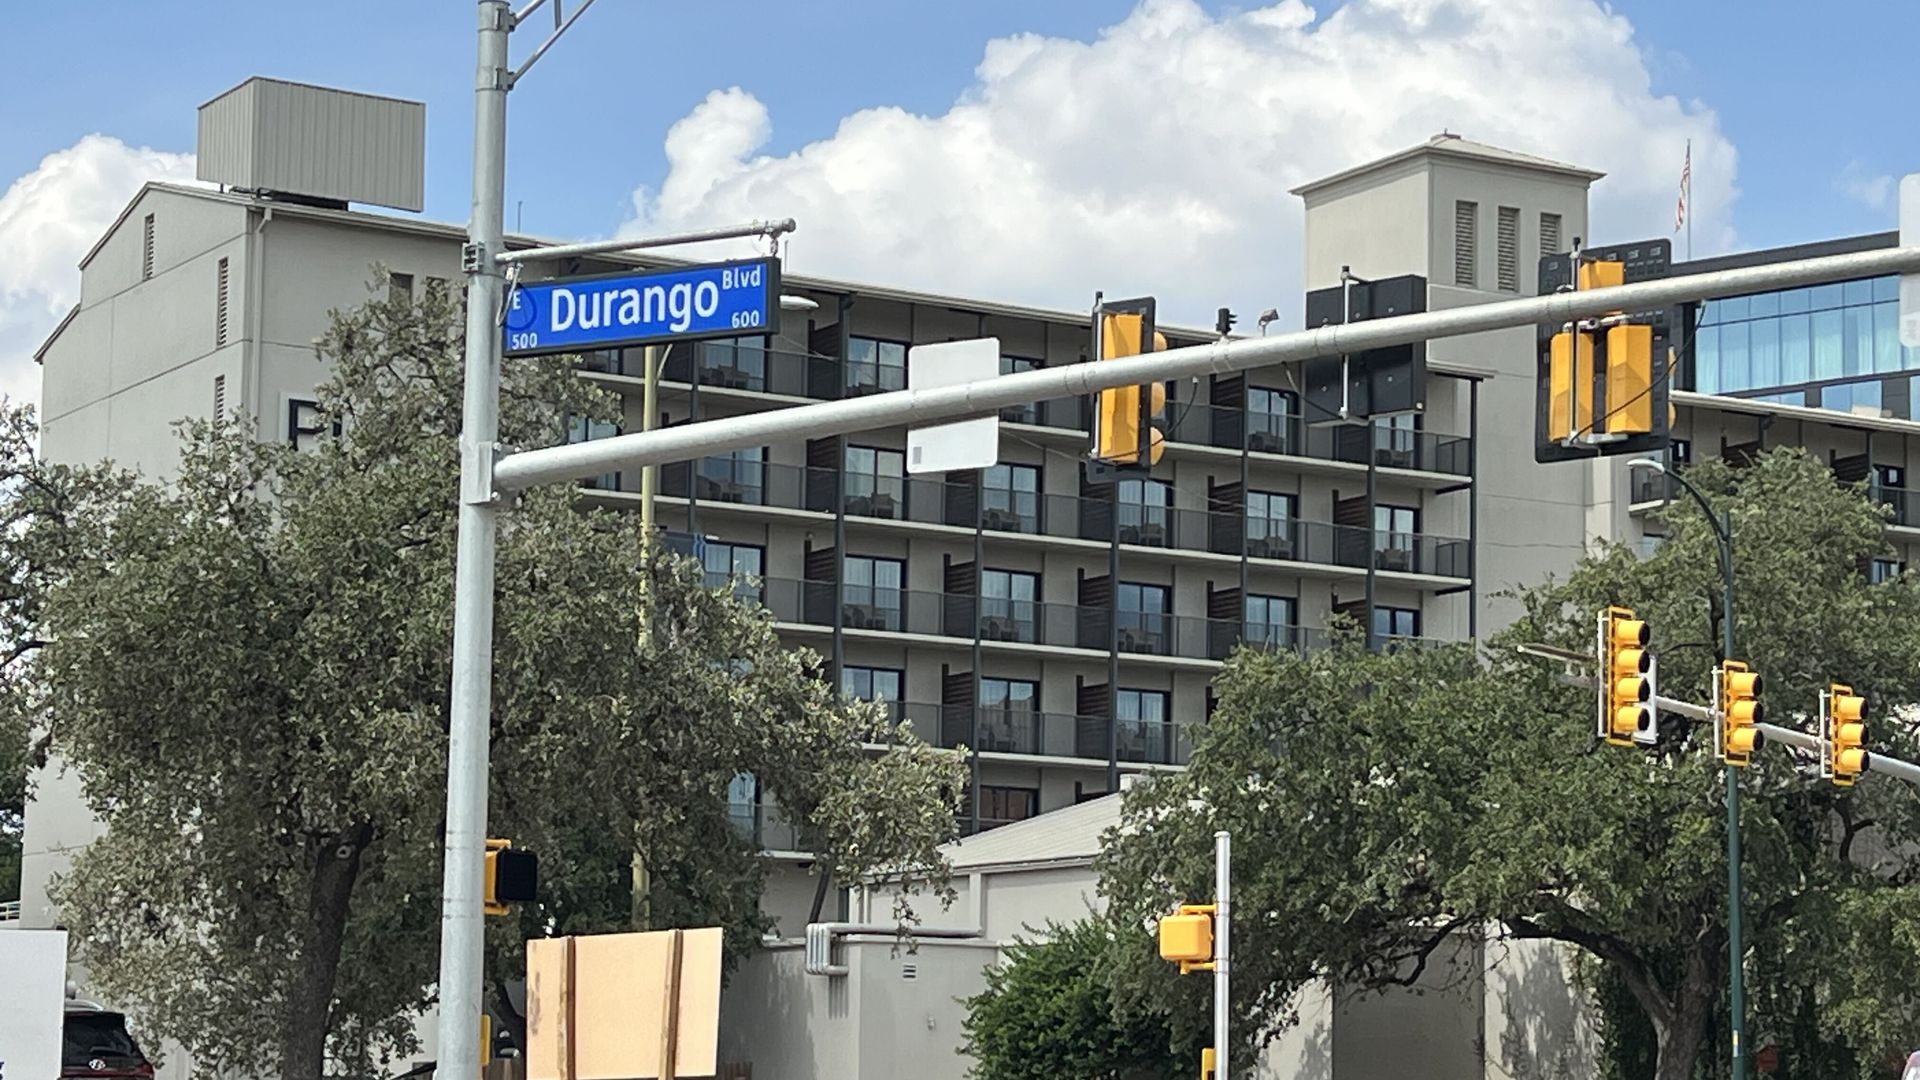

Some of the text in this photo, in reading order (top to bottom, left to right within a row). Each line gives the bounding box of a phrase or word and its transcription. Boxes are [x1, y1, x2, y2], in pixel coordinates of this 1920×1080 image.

[512, 264, 761, 333] E Durango Blvd
[731, 309, 760, 328] 600
[511, 332, 538, 350] 500
